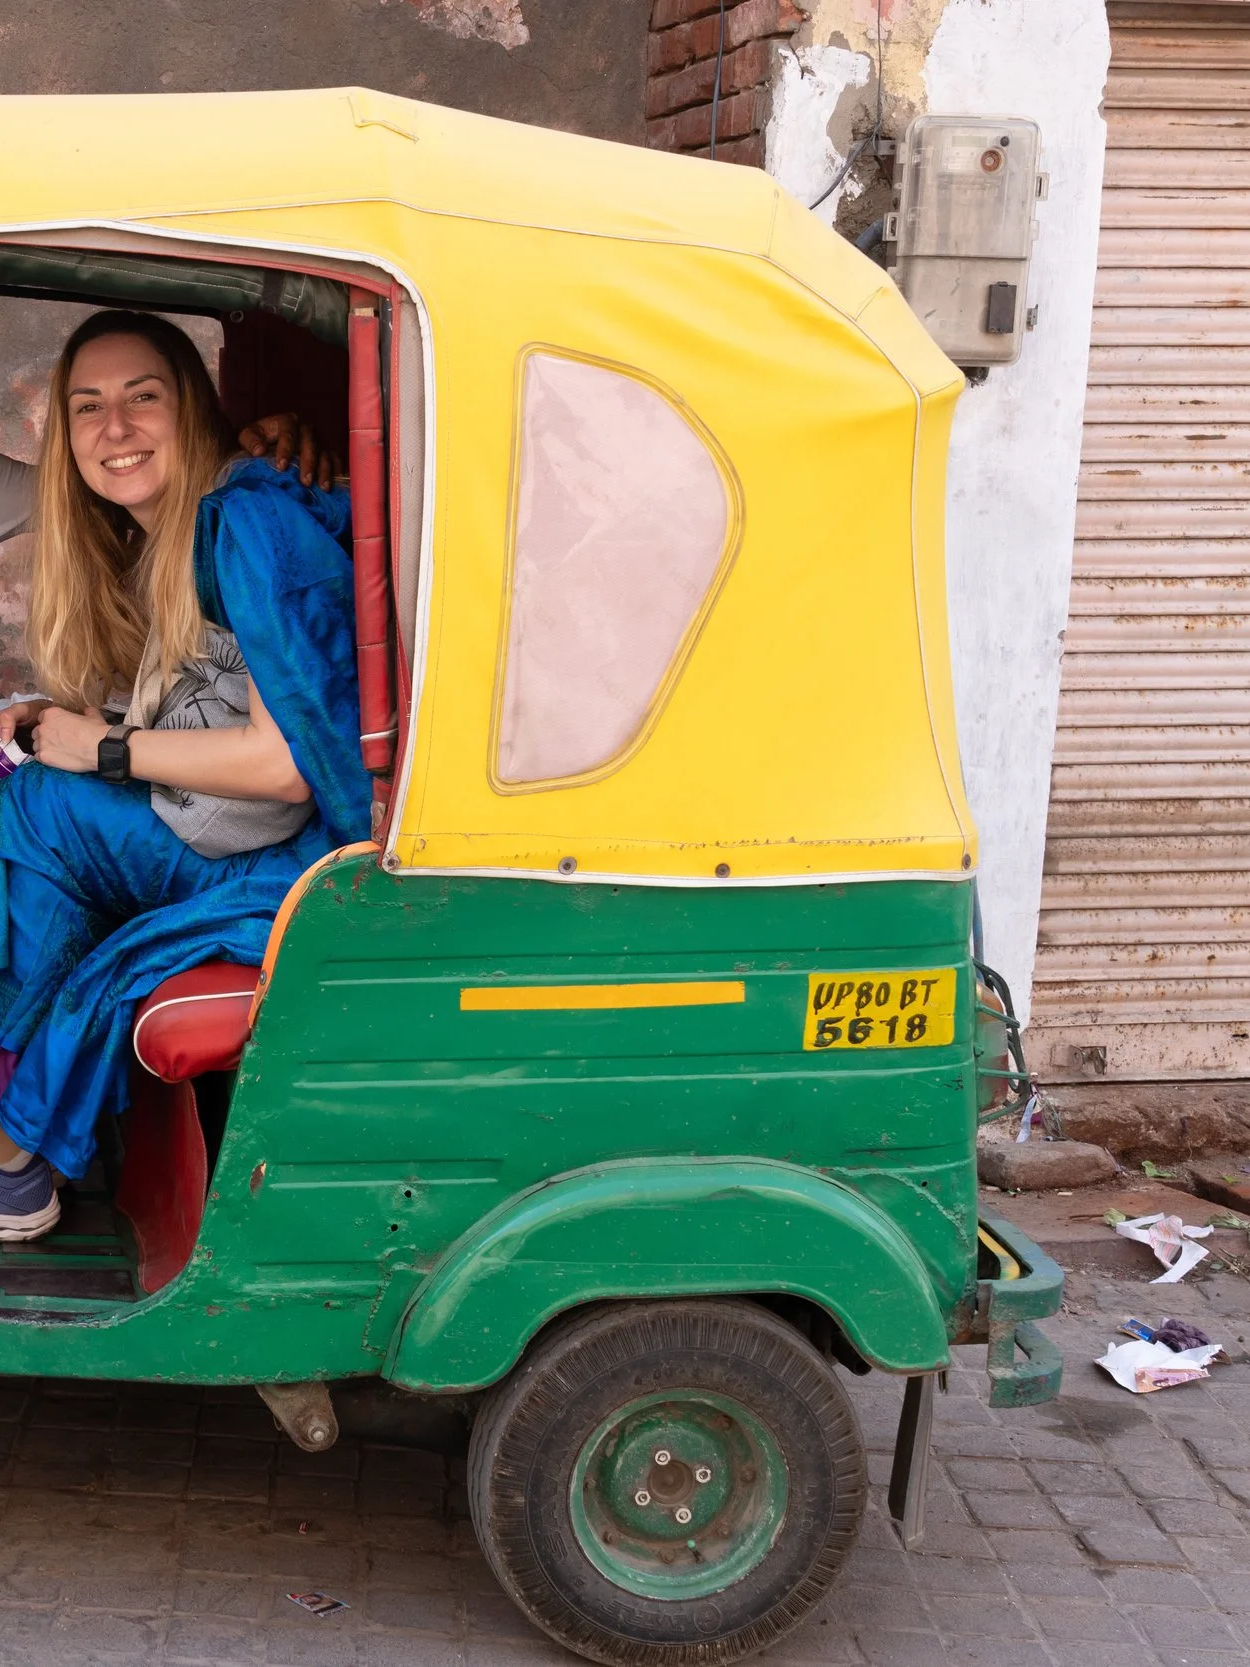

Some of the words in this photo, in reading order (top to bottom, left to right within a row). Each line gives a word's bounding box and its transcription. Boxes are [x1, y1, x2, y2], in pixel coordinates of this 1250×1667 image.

[813, 981, 891, 1014] UP80
[900, 978, 940, 1010] BT
[813, 1013, 928, 1047] 5618
